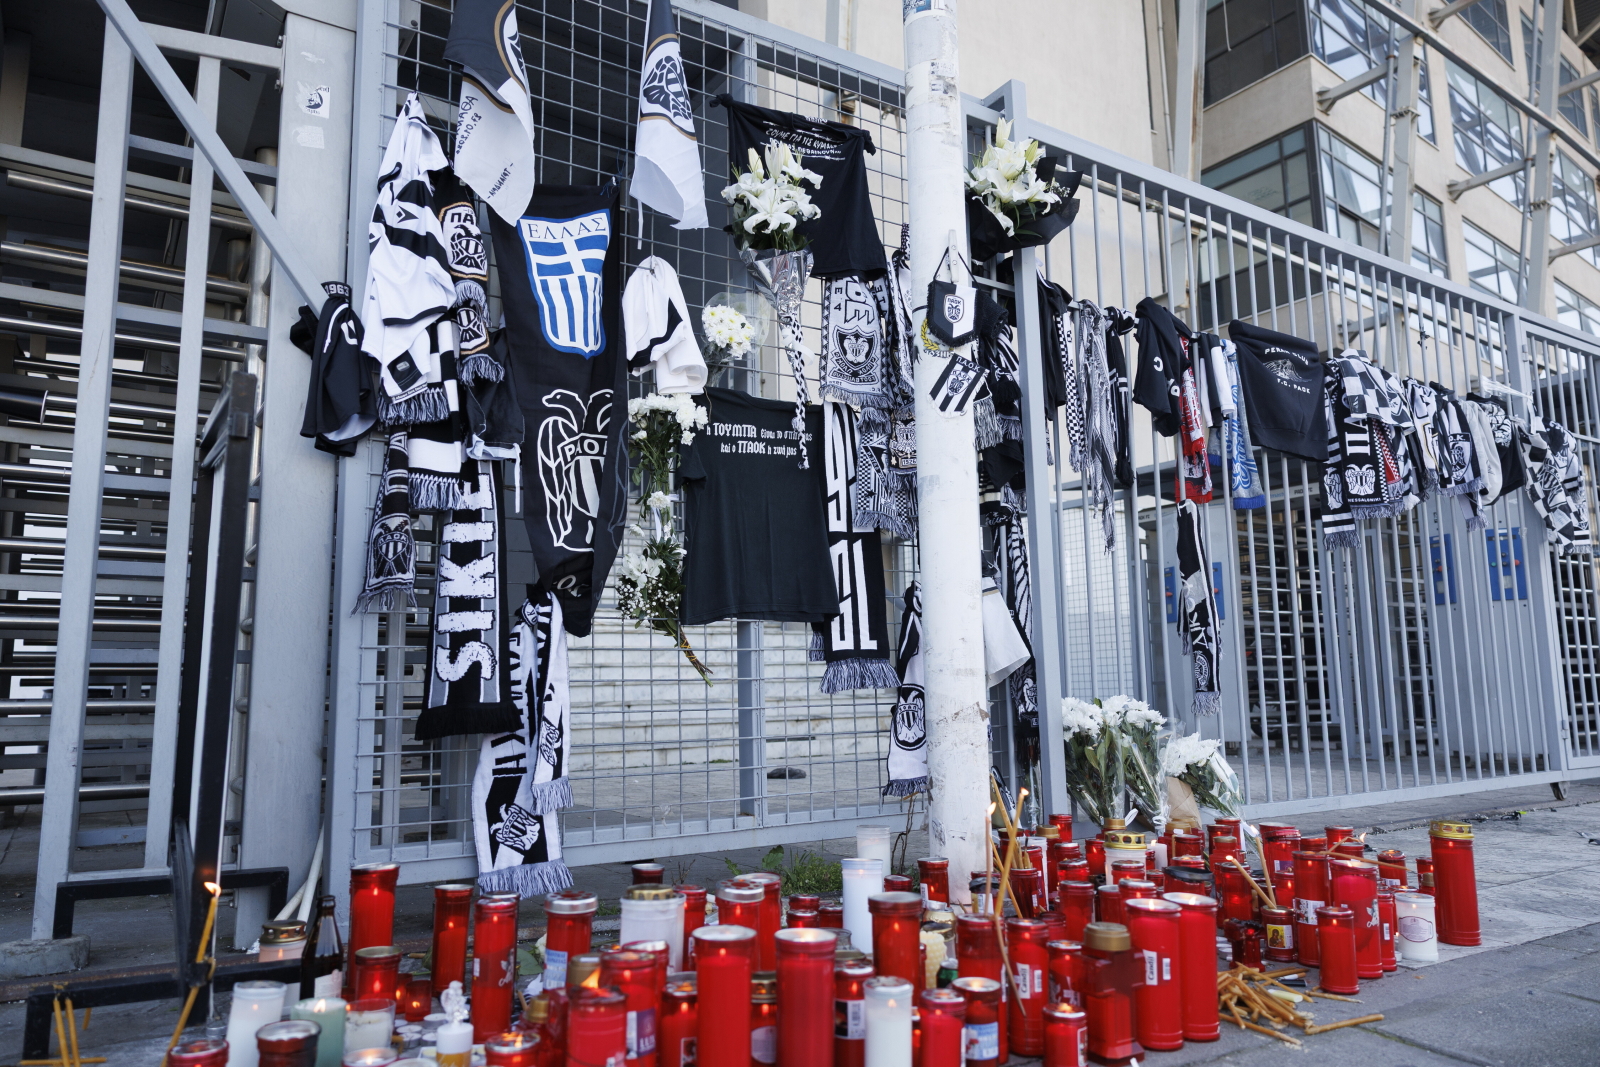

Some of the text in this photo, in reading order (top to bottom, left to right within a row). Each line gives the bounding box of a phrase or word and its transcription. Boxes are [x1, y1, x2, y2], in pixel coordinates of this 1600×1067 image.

[526, 217, 606, 240] ΕΛΛΑΣ
[324, 283, 349, 296] 1963
[713, 422, 757, 438] ΤΟΥΜΠΑ
[737, 440, 766, 454] ΠΑΟΚ
[379, 532, 408, 545] ΠΑΟΚ
